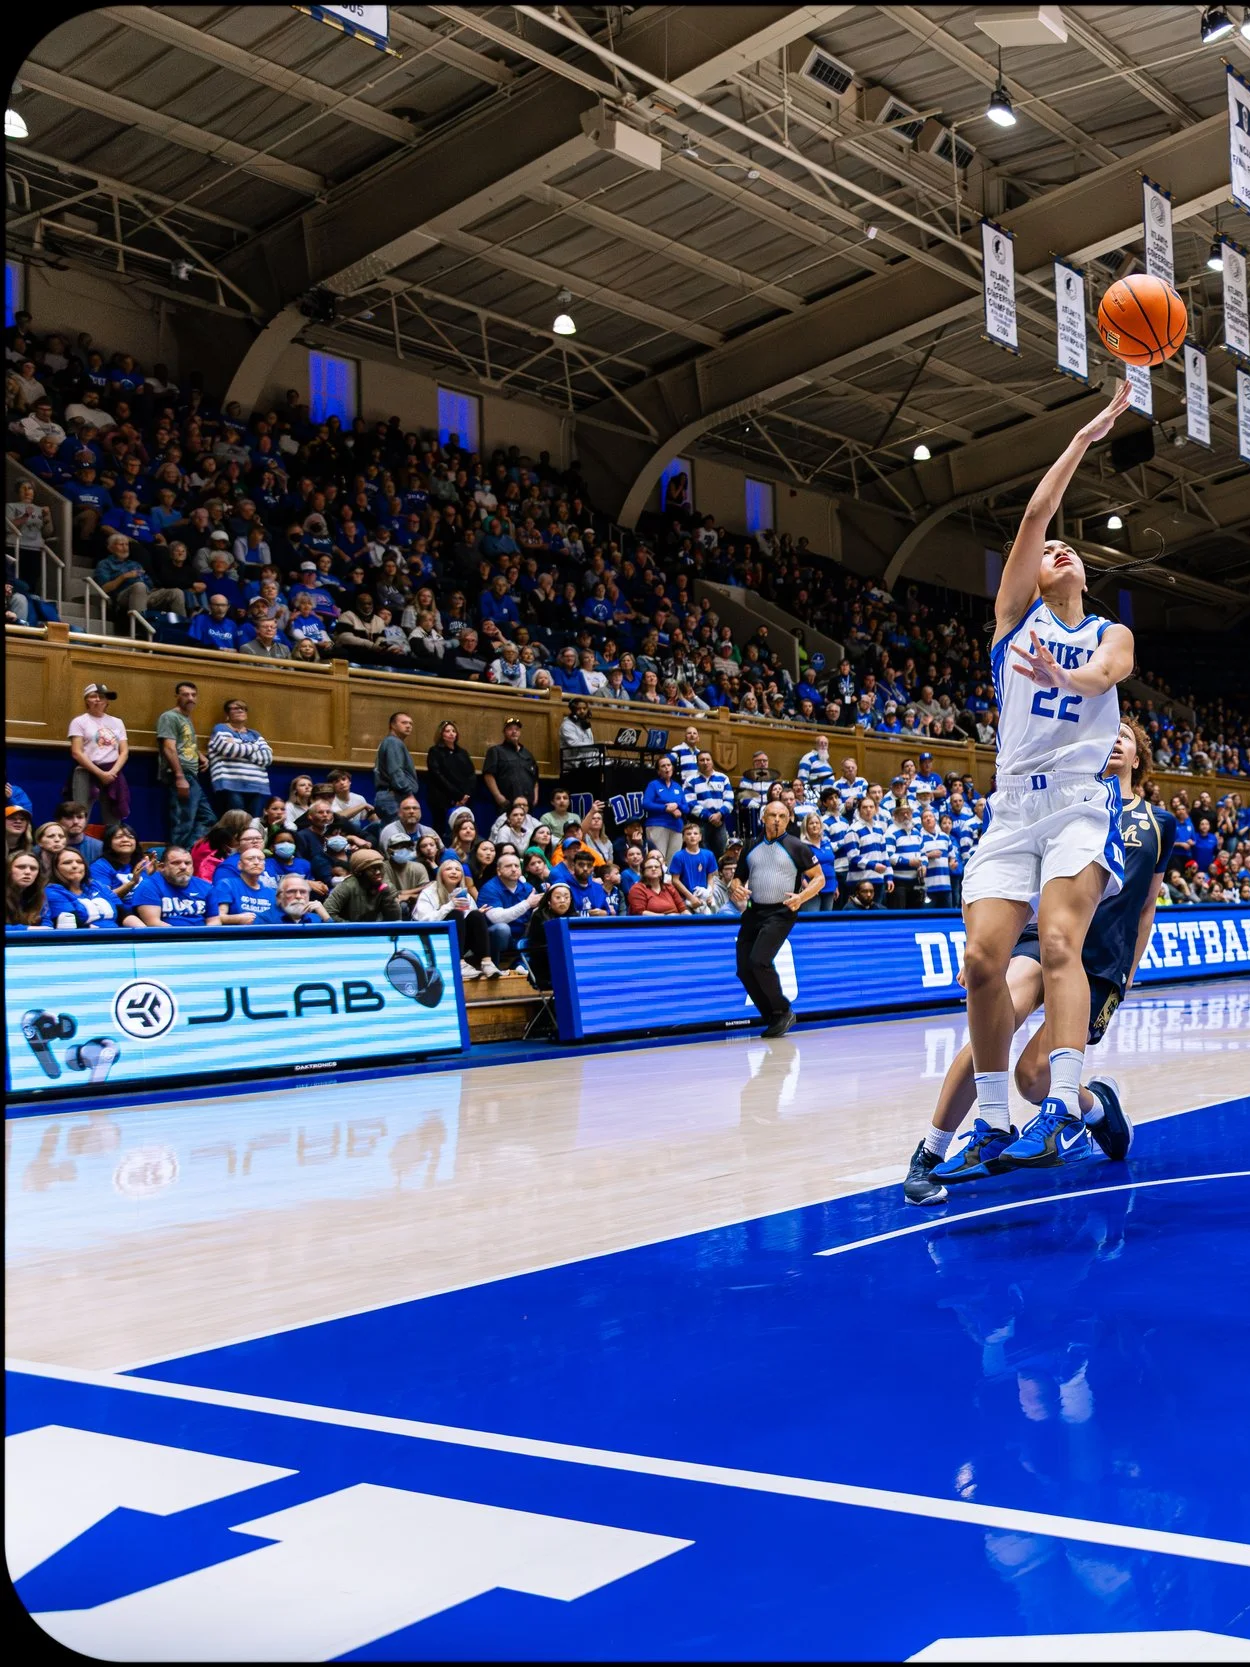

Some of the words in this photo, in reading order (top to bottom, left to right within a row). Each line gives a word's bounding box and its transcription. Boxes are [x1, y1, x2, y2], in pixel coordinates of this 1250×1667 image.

[1031, 687, 1083, 723] 22
[1031, 775, 1048, 791] D
[609, 791, 644, 825] DU
[187, 980, 386, 1025] JLAB
